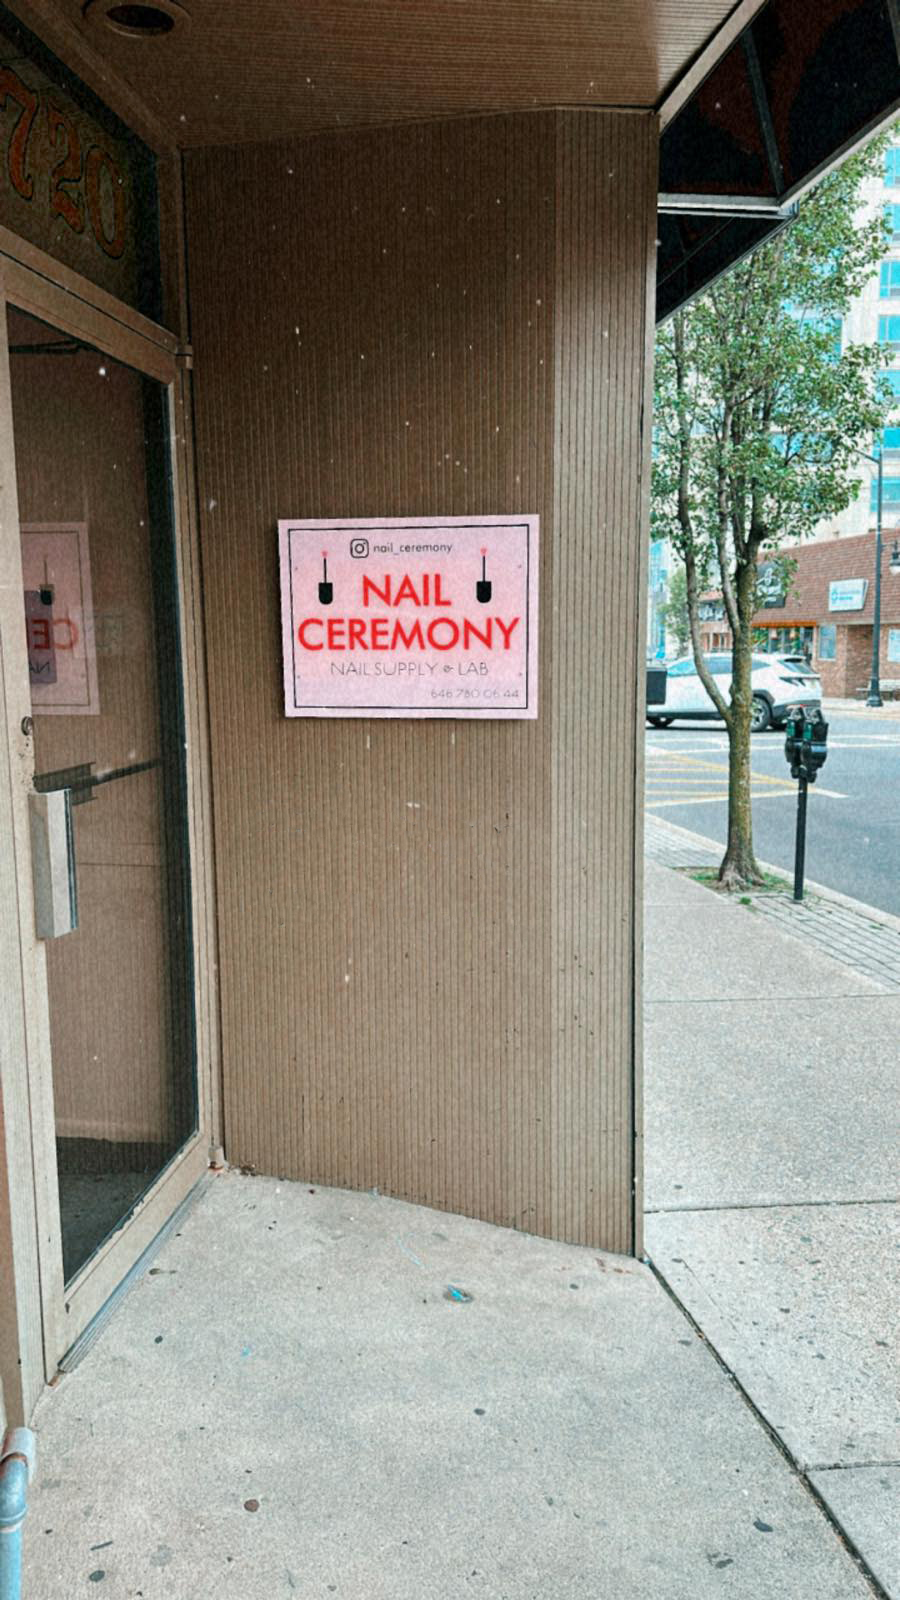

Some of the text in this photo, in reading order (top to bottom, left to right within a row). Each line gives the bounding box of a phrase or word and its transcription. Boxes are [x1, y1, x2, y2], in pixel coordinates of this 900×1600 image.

[0, 65, 125, 259] 720
[373, 542, 453, 556] nail_ceremony
[362, 573, 452, 608] NAIL
[297, 616, 520, 651] CEREMONY
[330, 662, 371, 676] NAIL
[374, 662, 438, 676] SUPPLY
[458, 662, 489, 676] LAB
